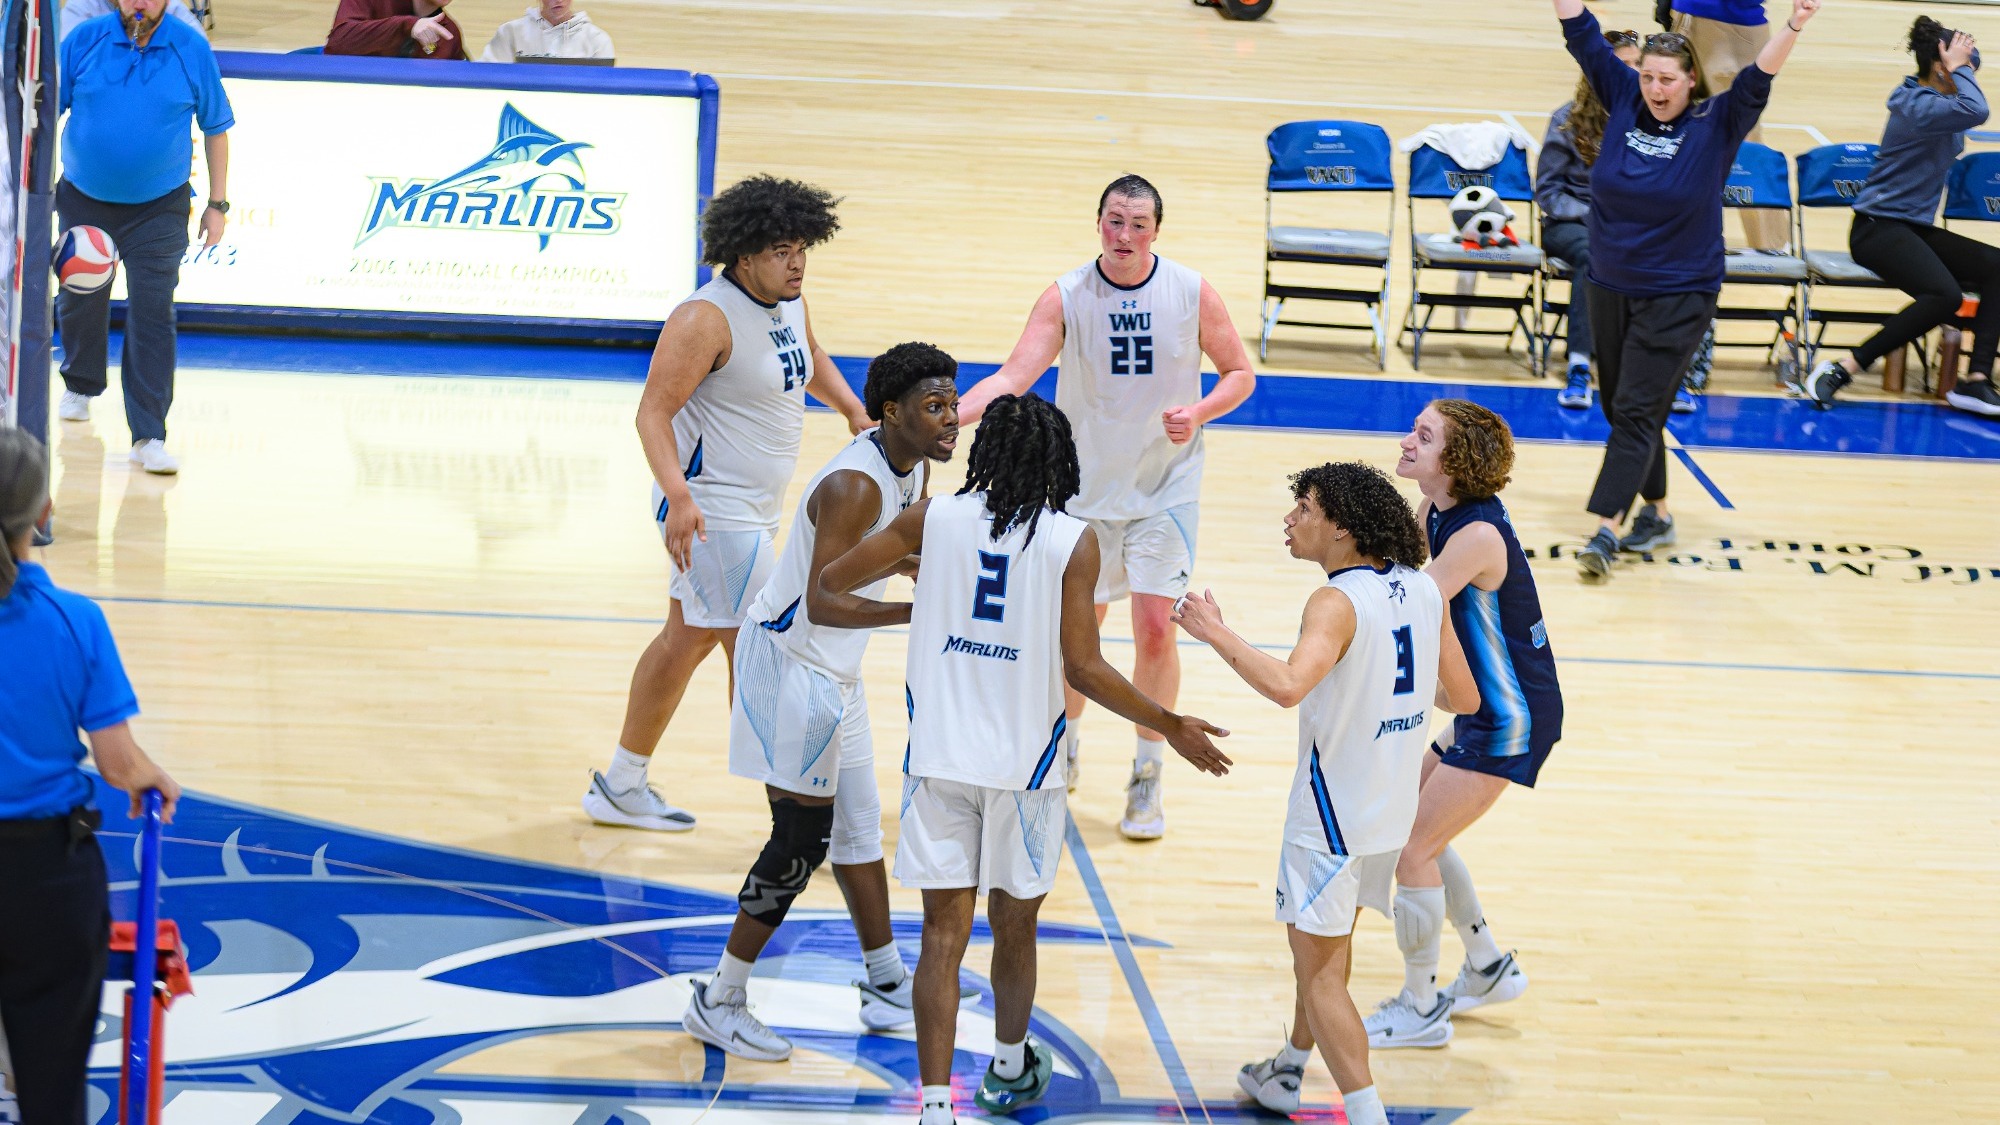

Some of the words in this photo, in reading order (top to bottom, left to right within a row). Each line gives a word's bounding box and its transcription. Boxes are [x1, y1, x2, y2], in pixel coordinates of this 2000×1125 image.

[405, 260, 502, 279] NATIONAL
[510, 264, 631, 285] CHAMPIONS
[767, 325, 797, 349] VWU
[1107, 311, 1152, 332] VWU
[777, 347, 808, 393] 24
[1107, 335, 1154, 376] 25
[971, 549, 1010, 623] 2
